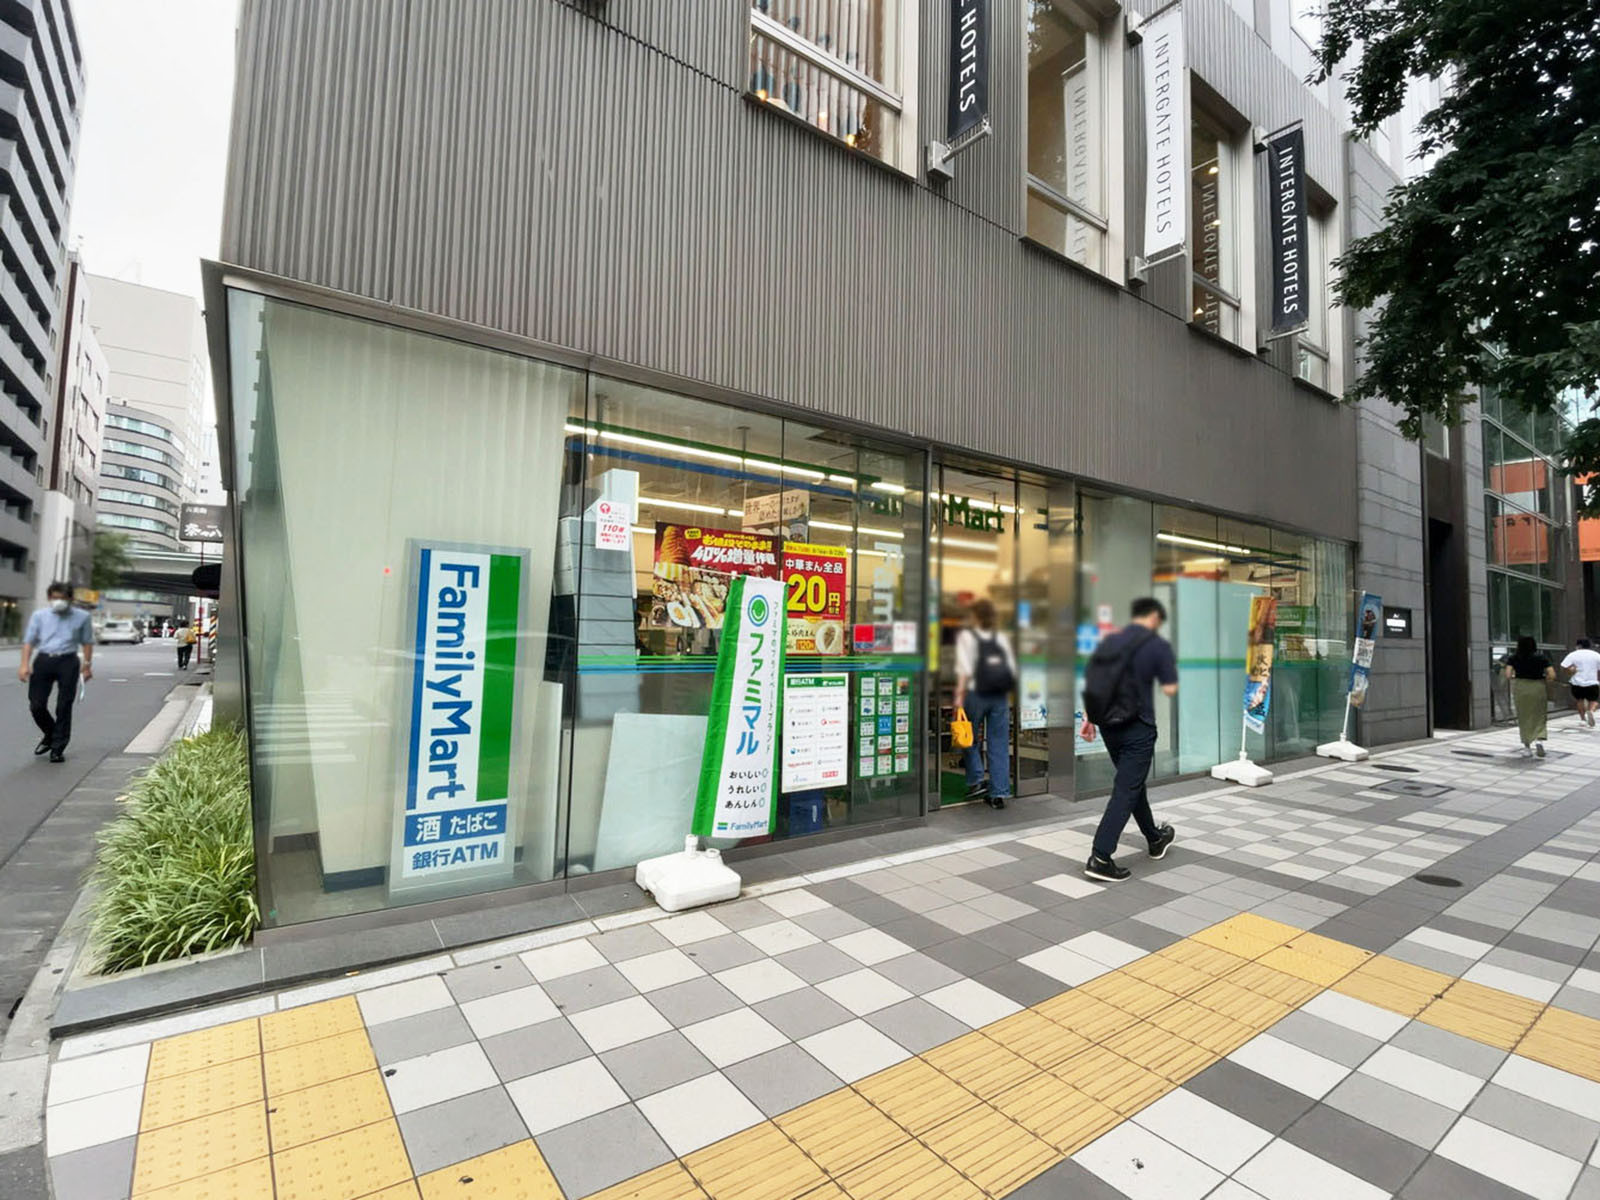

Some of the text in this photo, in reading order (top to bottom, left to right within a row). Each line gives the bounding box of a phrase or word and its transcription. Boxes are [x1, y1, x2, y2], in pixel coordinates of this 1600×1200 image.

[960, 11, 977, 113] HOTELS
[1153, 33, 1172, 235] INTERGATE HOTELS
[1279, 146, 1299, 315] INTERGATE HOTELS
[785, 558, 844, 574] 中華まん全品
[426, 563, 480, 800] FamilyMart
[736, 632, 764, 755] ファミマル
[412, 841, 499, 870] 銀行ATM
[415, 811, 498, 842] 酒 たばこ
[730, 820, 768, 831] FamilyMart
